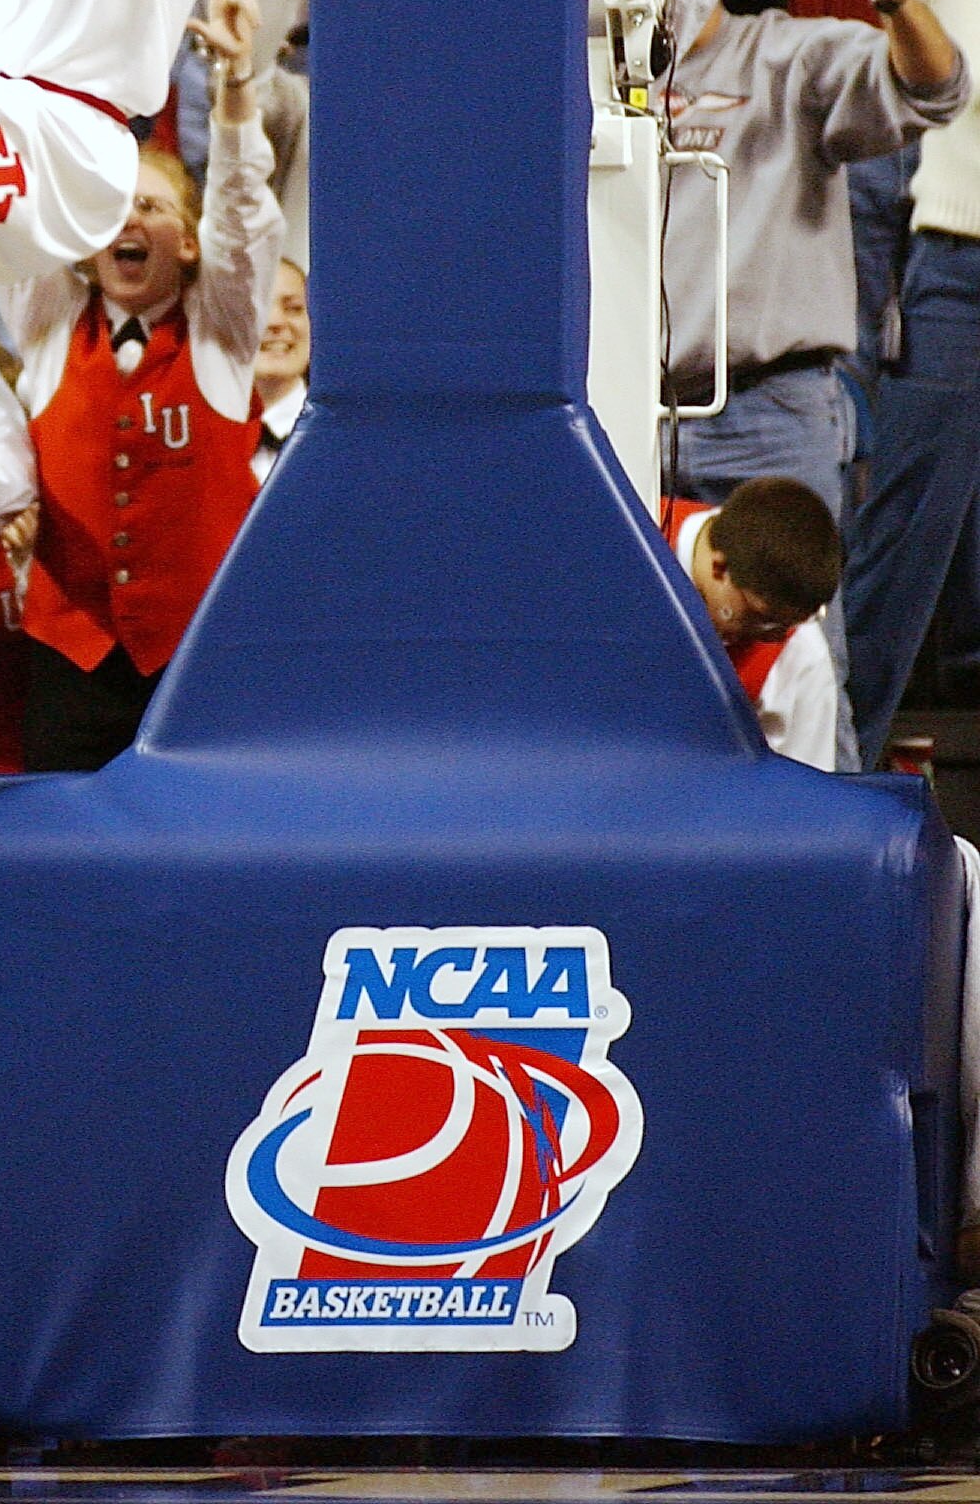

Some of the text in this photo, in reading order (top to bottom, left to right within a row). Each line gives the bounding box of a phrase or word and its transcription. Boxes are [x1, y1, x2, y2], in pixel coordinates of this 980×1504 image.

[139, 392, 190, 449] IU
[336, 946, 590, 1020] NCAA
[269, 1285, 512, 1320] BASKETBALL
